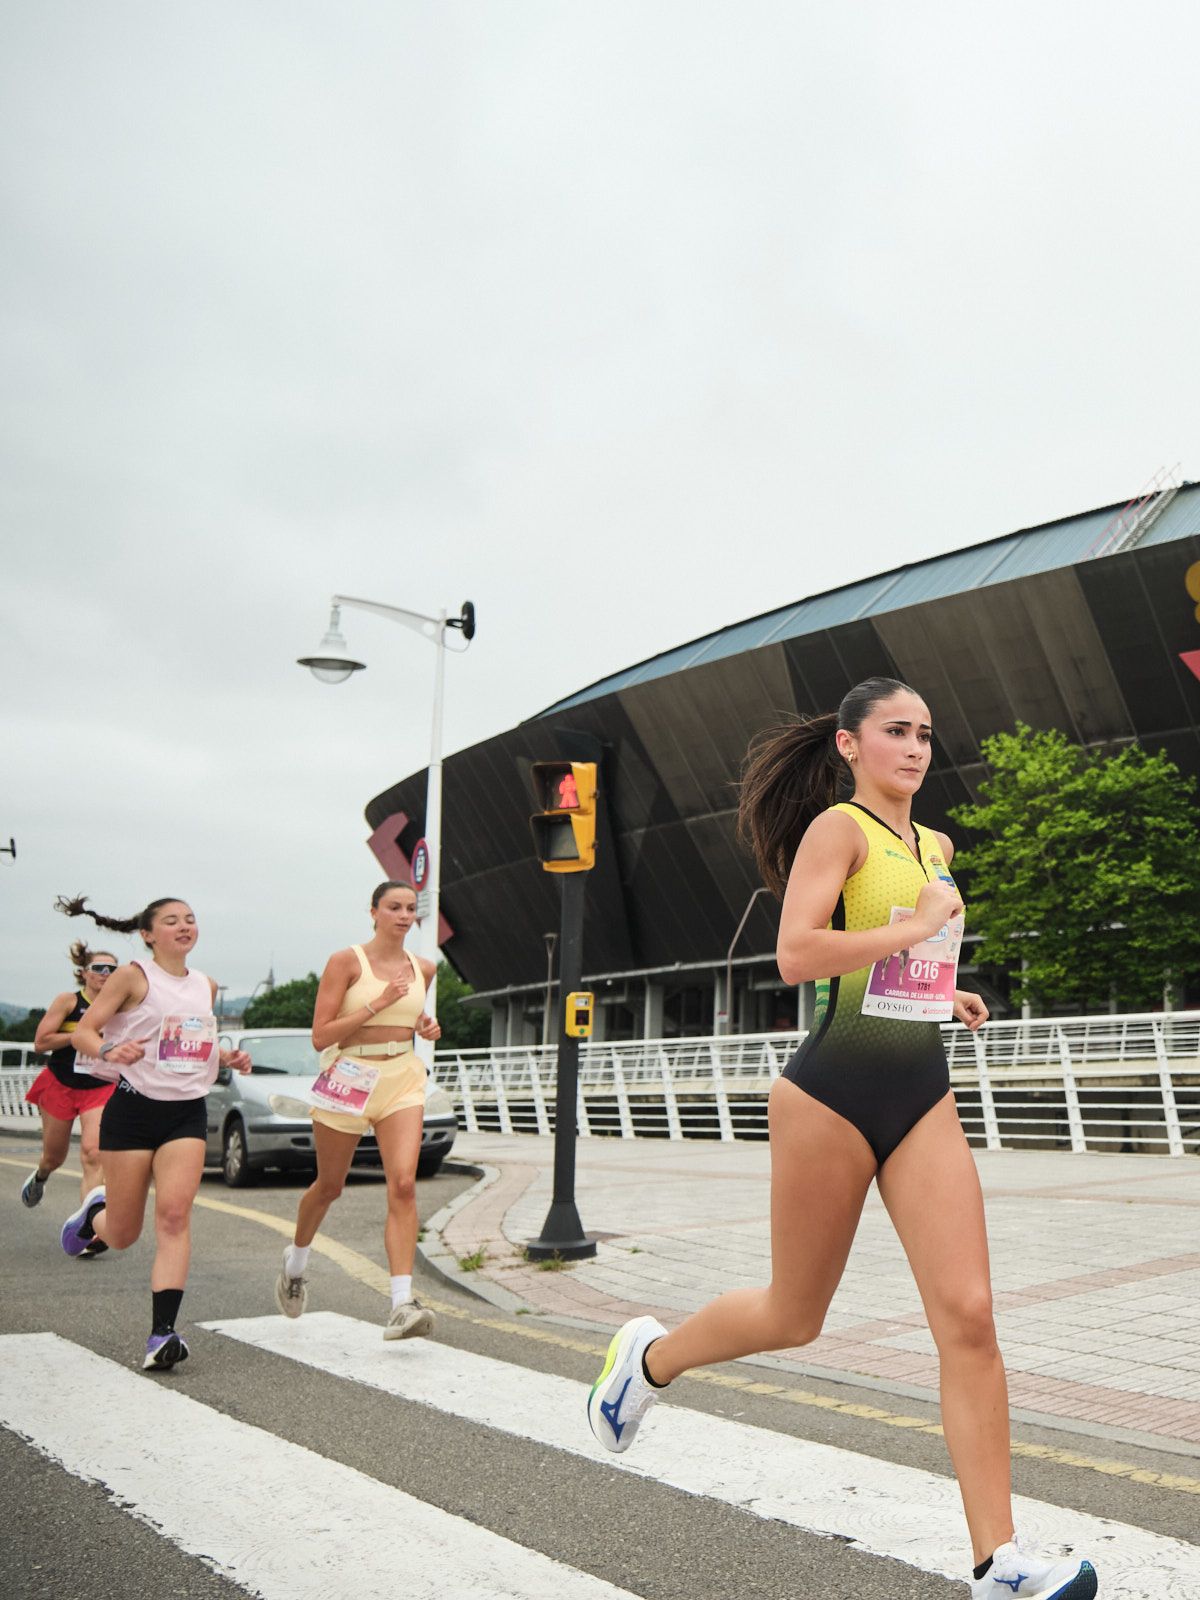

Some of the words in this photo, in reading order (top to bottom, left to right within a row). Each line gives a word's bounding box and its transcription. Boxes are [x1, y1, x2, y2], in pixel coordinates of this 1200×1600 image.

[910, 960, 940, 980] 016
[917, 982, 931, 991] 1781
[877, 1001, 913, 1013] OYSHO
[327, 1080, 351, 1096] 016
